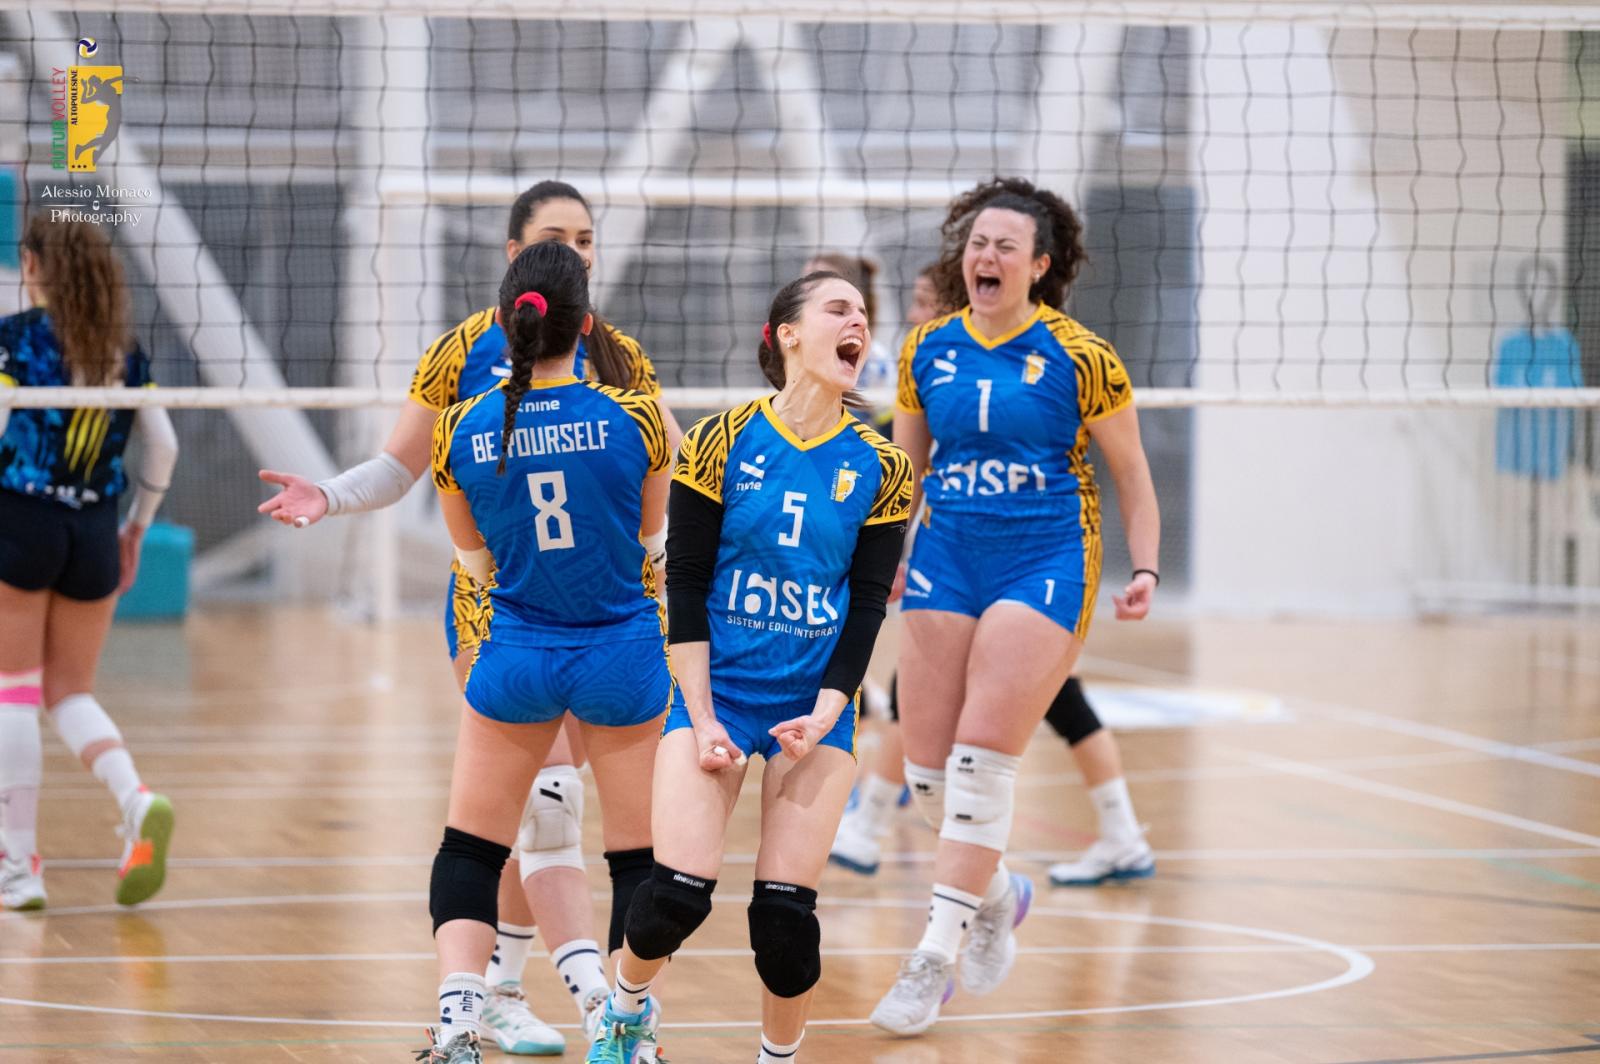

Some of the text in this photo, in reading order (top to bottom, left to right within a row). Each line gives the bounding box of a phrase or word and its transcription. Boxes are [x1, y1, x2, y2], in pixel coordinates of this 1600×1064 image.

[525, 400, 560, 412] nine
[976, 379, 992, 432] 1
[471, 432, 498, 463] BE
[527, 470, 575, 552] 8
[778, 491, 807, 547] 5
[1045, 579, 1055, 605] 1
[727, 615, 765, 630] SISTEMI
[768, 621, 792, 634] EDILI
[460, 990, 474, 1012] nine
